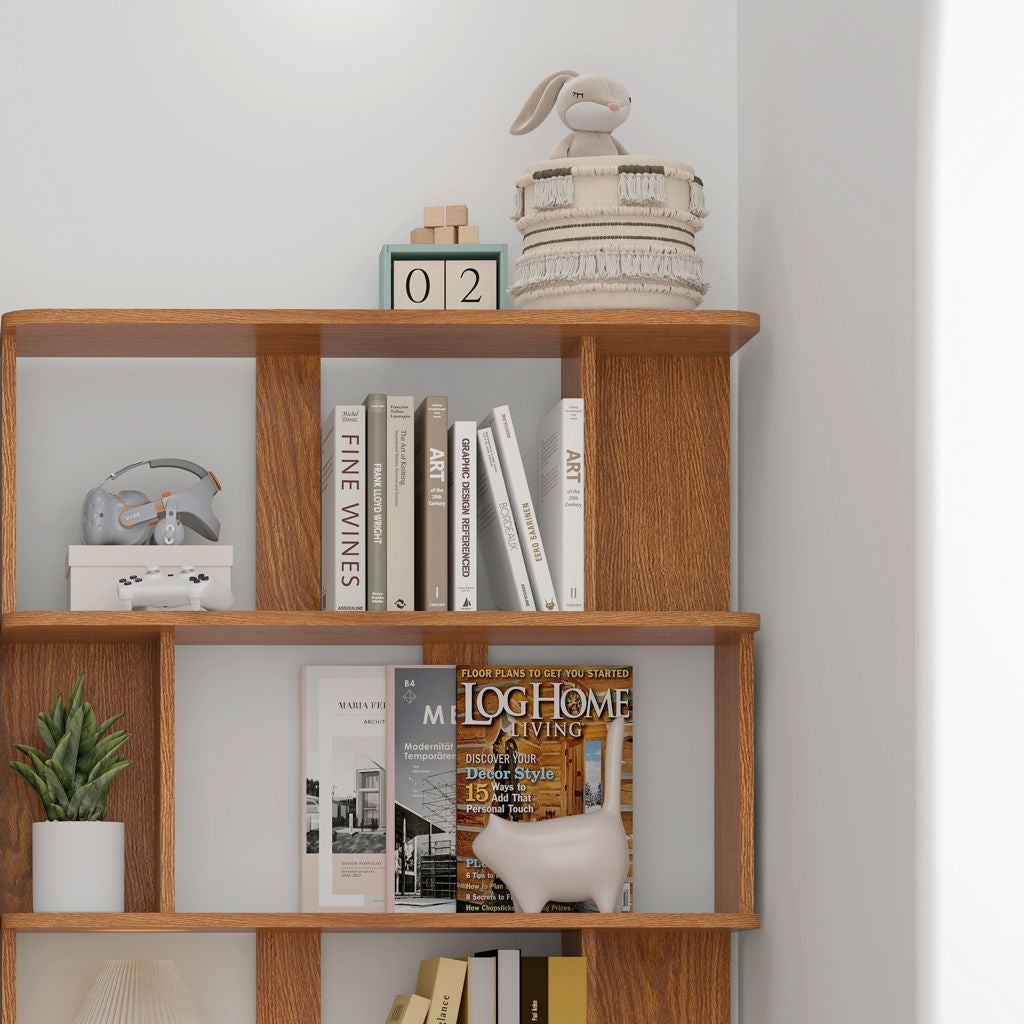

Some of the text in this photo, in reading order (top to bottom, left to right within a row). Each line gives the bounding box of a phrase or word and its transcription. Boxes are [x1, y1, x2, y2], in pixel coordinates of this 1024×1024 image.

[430, 447, 445, 482] ART
[461, 438, 470, 479] GRAPHIC
[566, 449, 581, 483] ART
[341, 435, 360, 587] FINE WINES
[373, 463, 382, 544] FRANK LLOYD WRIGHT
[461, 482, 470, 515] DESIGN
[499, 502, 518, 551] BORDEAUX
[522, 502, 543, 562] EERO SAARINEN
[461, 518, 470, 577] REFERENCED
[404, 680, 415, 688] B4
[461, 669, 629, 678] FLOOR PLANS TO GET YOU STARTED
[404, 742, 453, 751] Modernität
[512, 722, 583, 737] LIVING
[465, 767, 554, 782] Decor Style
[465, 783, 489, 802] 15
